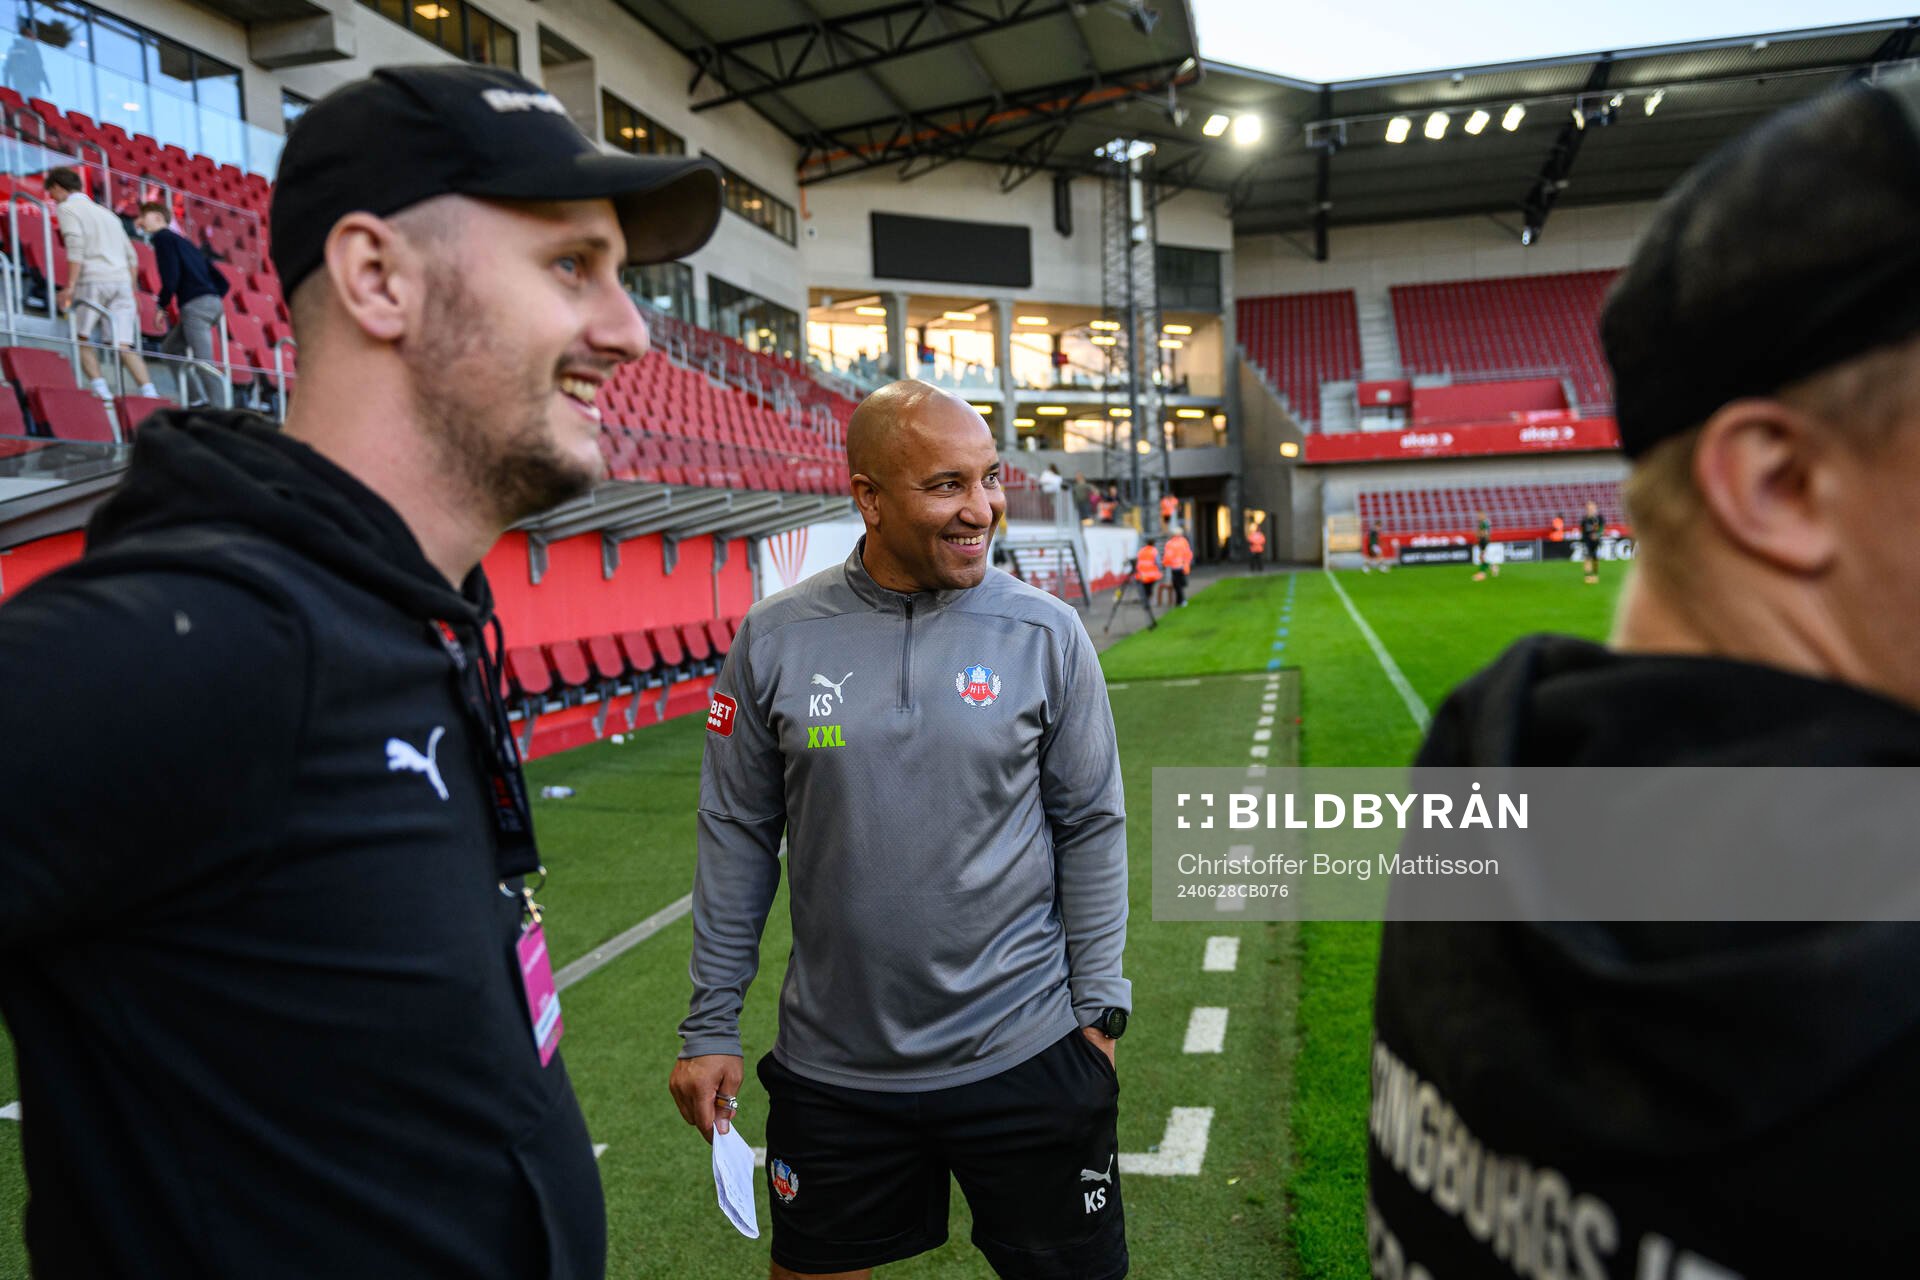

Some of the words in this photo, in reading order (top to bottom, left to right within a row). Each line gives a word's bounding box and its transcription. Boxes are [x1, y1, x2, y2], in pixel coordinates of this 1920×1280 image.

[970, 684, 987, 695] HIF
[710, 700, 732, 720] BET
[809, 694, 833, 718] KS
[807, 725, 846, 749] XXL
[1084, 1187, 1107, 1214] KS
